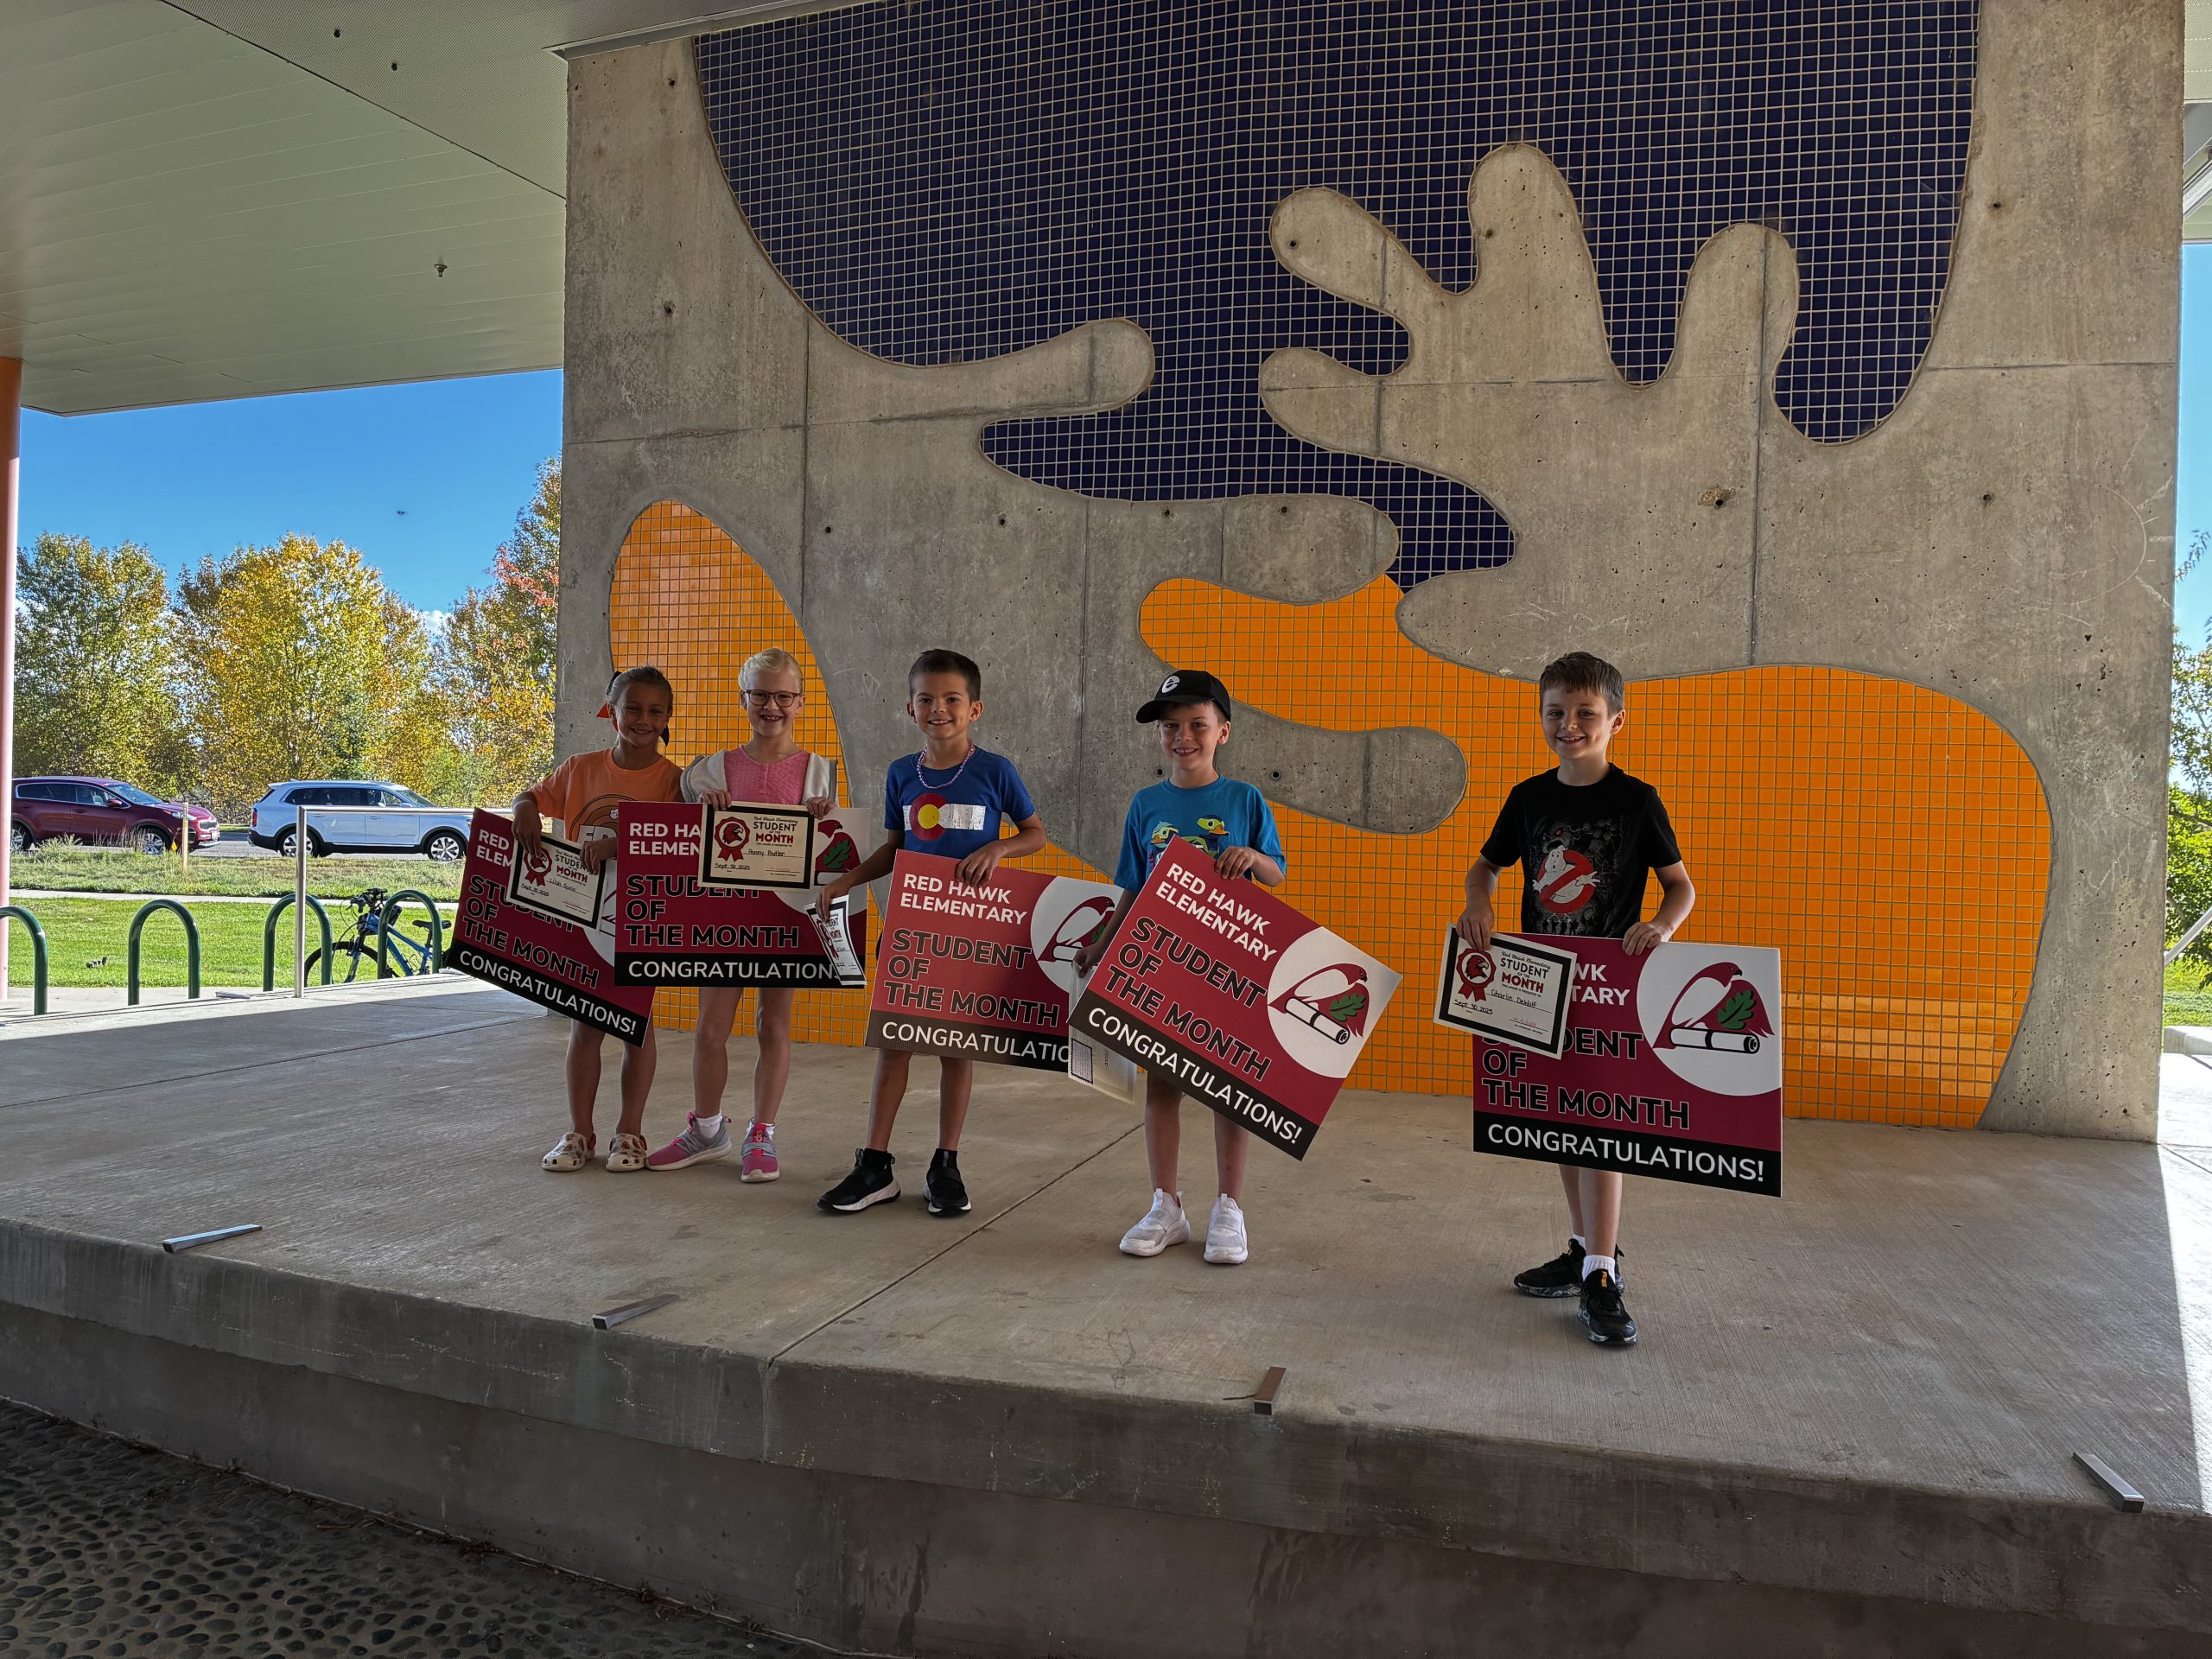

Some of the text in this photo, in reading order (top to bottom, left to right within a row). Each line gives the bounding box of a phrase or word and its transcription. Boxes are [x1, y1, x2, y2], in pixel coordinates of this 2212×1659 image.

[478, 829, 510, 850] RED
[629, 823, 668, 837] RED
[674, 823, 701, 838] HA
[753, 821, 797, 832] STUDENT
[755, 833, 793, 844] MONTH
[555, 854, 588, 872] STUDEN
[629, 841, 700, 856] ELEMEN
[556, 865, 588, 883] MONTH
[903, 873, 1013, 905] RED HAWK
[466, 897, 499, 922] OF
[626, 899, 666, 922] OF
[899, 893, 1027, 925] ELEMENTARY
[1166, 862, 1271, 936] RED HAWK
[624, 925, 799, 948] THE MONTH
[1155, 880, 1278, 963] ELEMENTARY
[462, 917, 600, 989] THE MONTH
[892, 927, 1032, 969] STUDENT
[1118, 942, 1163, 978] OF
[628, 961, 838, 979] CONGRATULATION
[887, 955, 930, 981] OF
[1130, 917, 1268, 1010] STUDENT
[1500, 957, 1548, 979] STUDENT
[460, 950, 637, 1035] CONGRATULATIONS!
[1501, 971, 1544, 994] MONTH
[884, 981, 1059, 1027] THE MONTH
[1103, 965, 1166, 1017] THE
[1164, 1002, 1271, 1082] MONTH
[881, 1021, 1069, 1062] CONGRATULATIO
[1088, 1007, 1303, 1145] CONGRATULATIONS!
[1482, 1048, 1528, 1077] OF
[1482, 1077, 1690, 1130] THE MONTH
[1487, 1123, 1764, 1182] CONGRATULATIONS!
